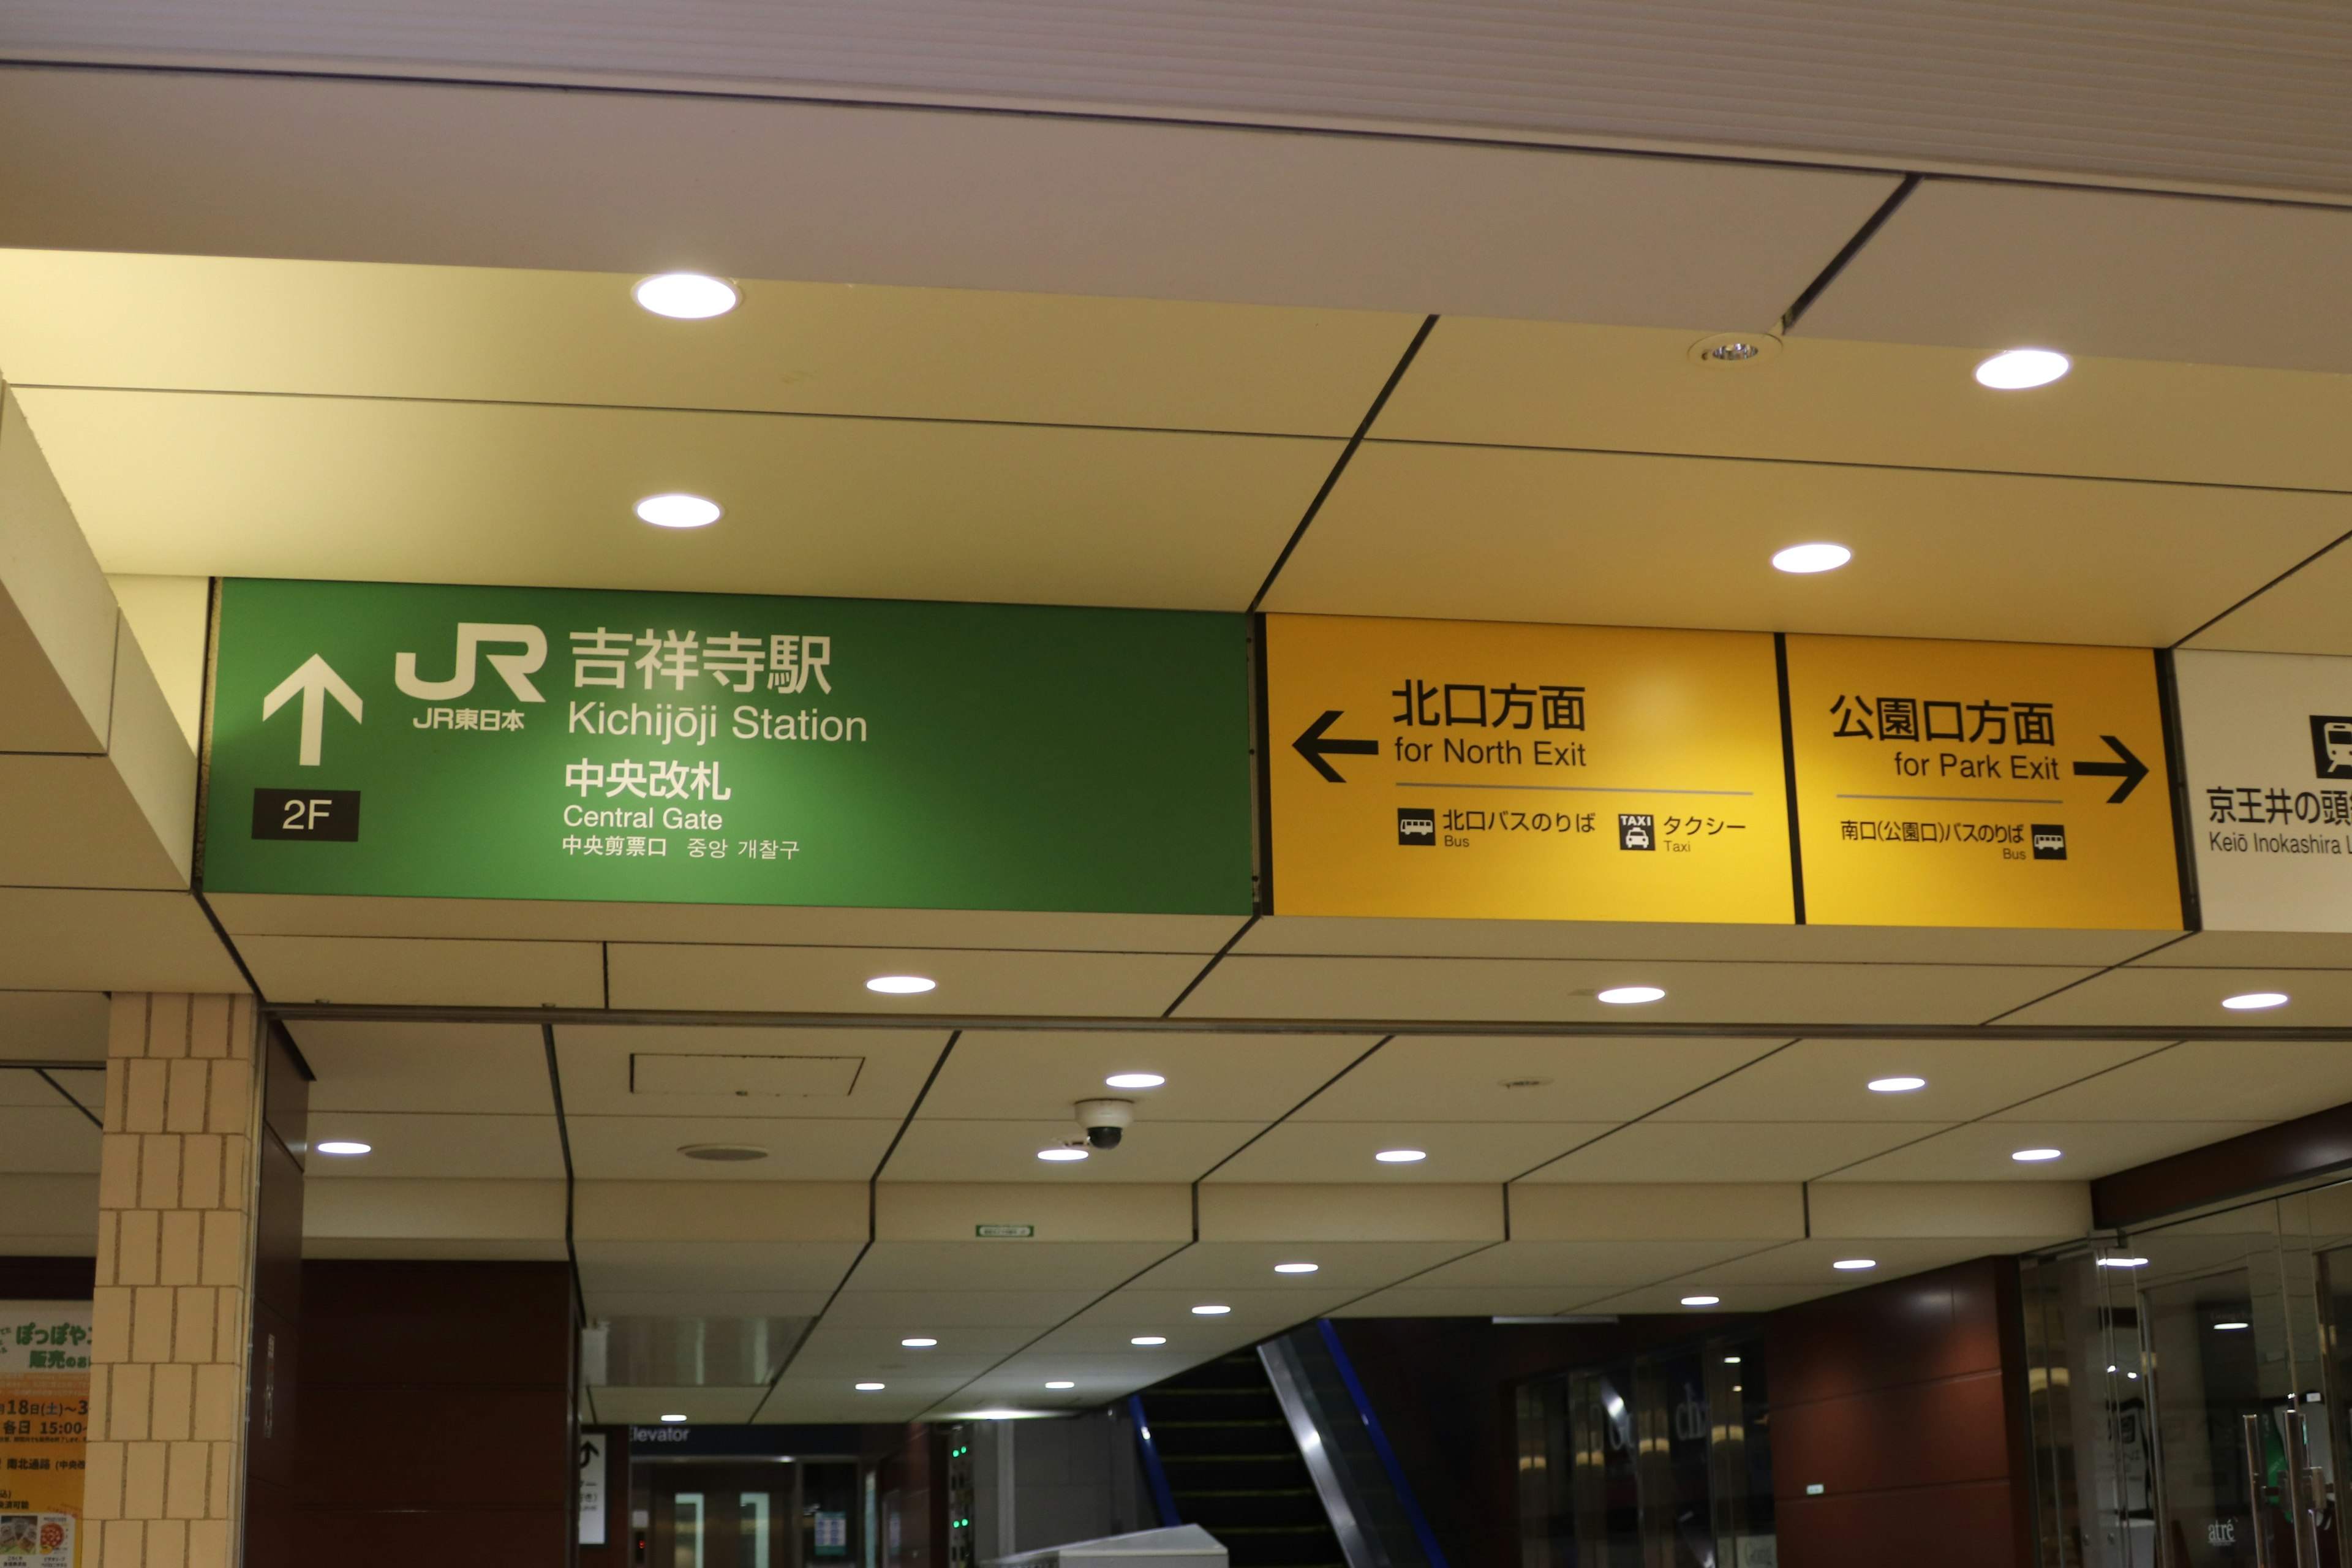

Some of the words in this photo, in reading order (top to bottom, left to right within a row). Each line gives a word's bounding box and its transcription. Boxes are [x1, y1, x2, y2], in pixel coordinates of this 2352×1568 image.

[394, 622, 548, 703] JR
[568, 627, 832, 695] 吉祥寺駅
[1392, 679, 1586, 731] 北口方面
[413, 707, 525, 732] JR東日本
[568, 700, 717, 746] Kichijōji
[732, 705, 867, 742] Station
[1829, 694, 2056, 746] 公園口方面
[1395, 737, 1433, 763] for
[1444, 737, 1522, 765] North
[1534, 741, 1586, 767] Exit
[1893, 751, 1931, 777] for
[1940, 754, 2002, 780] Park
[2011, 756, 2060, 781] Exit
[565, 757, 731, 801] 中央改札
[282, 799, 333, 830] 2F
[563, 805, 654, 829] Central
[662, 808, 723, 831] Gate
[2206, 786, 2352, 826] 京王井の頭
[1442, 809, 1596, 833] 北口バスのりば
[1620, 815, 1651, 826] TAXI
[1664, 815, 1746, 835] タクシー
[1841, 820, 2024, 843] 南口(公園口)バスのりば
[562, 835, 667, 858] 中央剪票口
[687, 838, 728, 859] 중앙
[737, 840, 800, 860] 개찰구
[1444, 835, 1470, 848] Bus
[1664, 840, 1691, 852] Taxi
[2003, 848, 2026, 859] Bus
[2209, 831, 2248, 852] Keiō
[2253, 833, 2342, 854] Inokashira
[16, 1322, 92, 1346] ぽっぽや
[29, 1350, 91, 1369] 販売のお
[2207, 1518, 2234, 1541] atré
